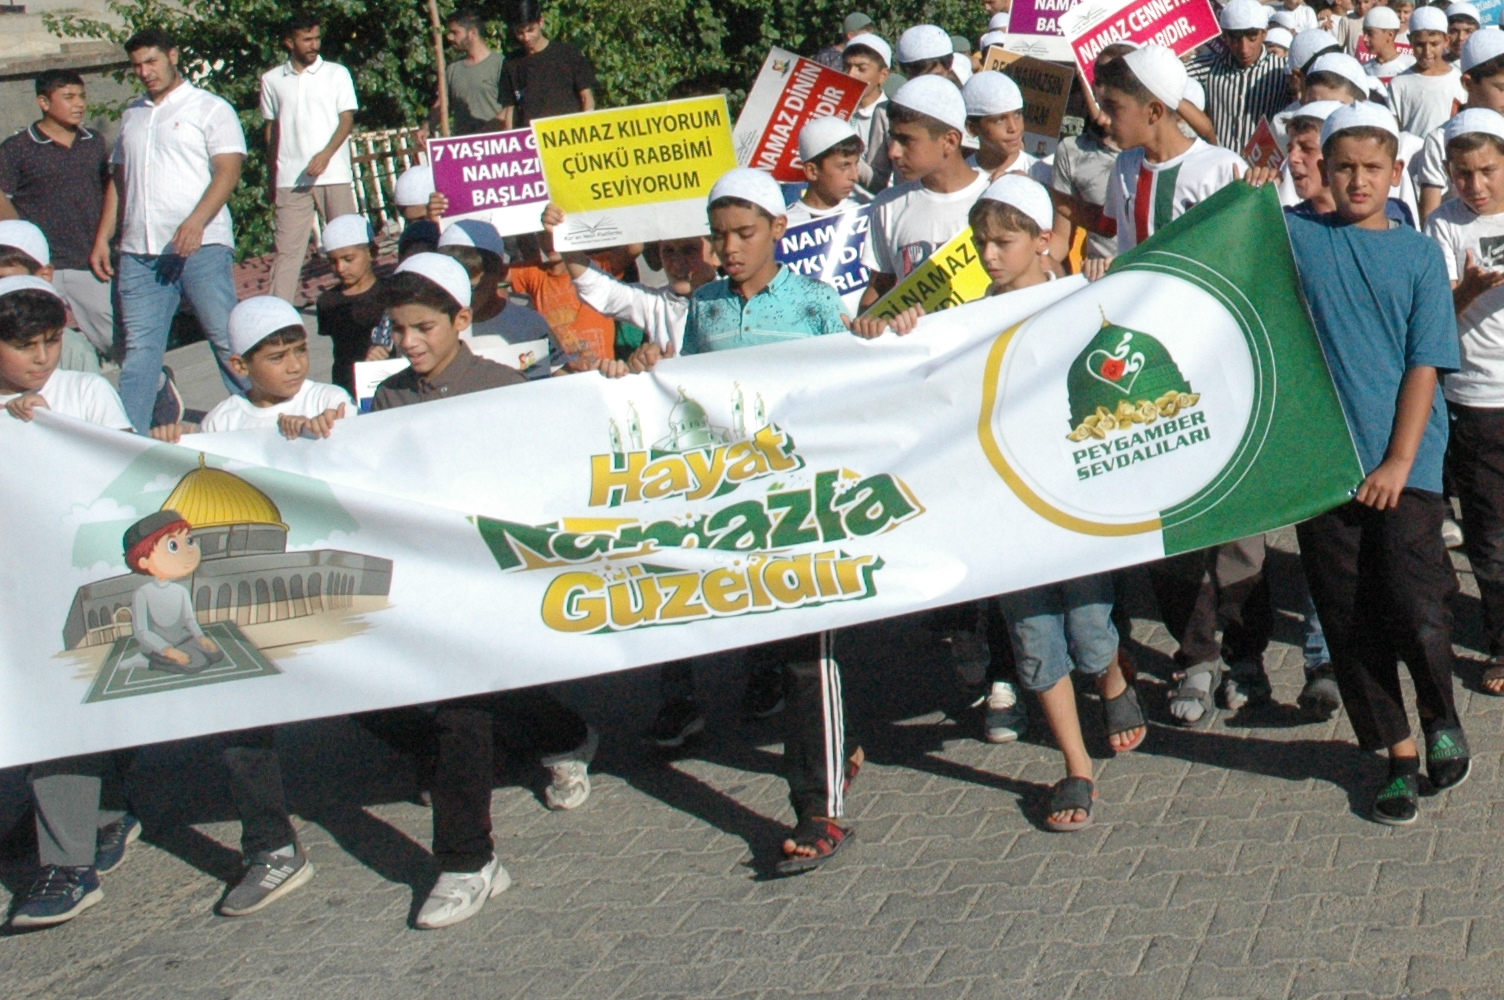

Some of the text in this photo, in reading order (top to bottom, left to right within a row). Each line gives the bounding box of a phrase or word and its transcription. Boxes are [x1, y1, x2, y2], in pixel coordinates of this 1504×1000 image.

[1078, 18, 1132, 65] NAMAZ
[784, 62, 822, 112] DİNİN
[433, 145, 445, 163] 7
[447, 137, 522, 162] YAŞIMA
[542, 123, 615, 149] NAMAZ
[618, 109, 722, 139] KILIYORUM
[463, 158, 542, 183] NAMAZI
[562, 147, 630, 179] ÇÜNKÜ
[634, 135, 714, 165] RABBİMİ
[472, 180, 549, 208] BAŞLAD
[590, 171, 701, 201] SEVİYORUM
[901, 243, 977, 307] NAMAZ
[1072, 410, 1207, 465] PEYGAMBER
[1076, 426, 1211, 481] SEVDALILARI
[588, 423, 804, 508] Hayat
[466, 467, 926, 573] Namazla
[541, 549, 886, 635] Güzeldir
